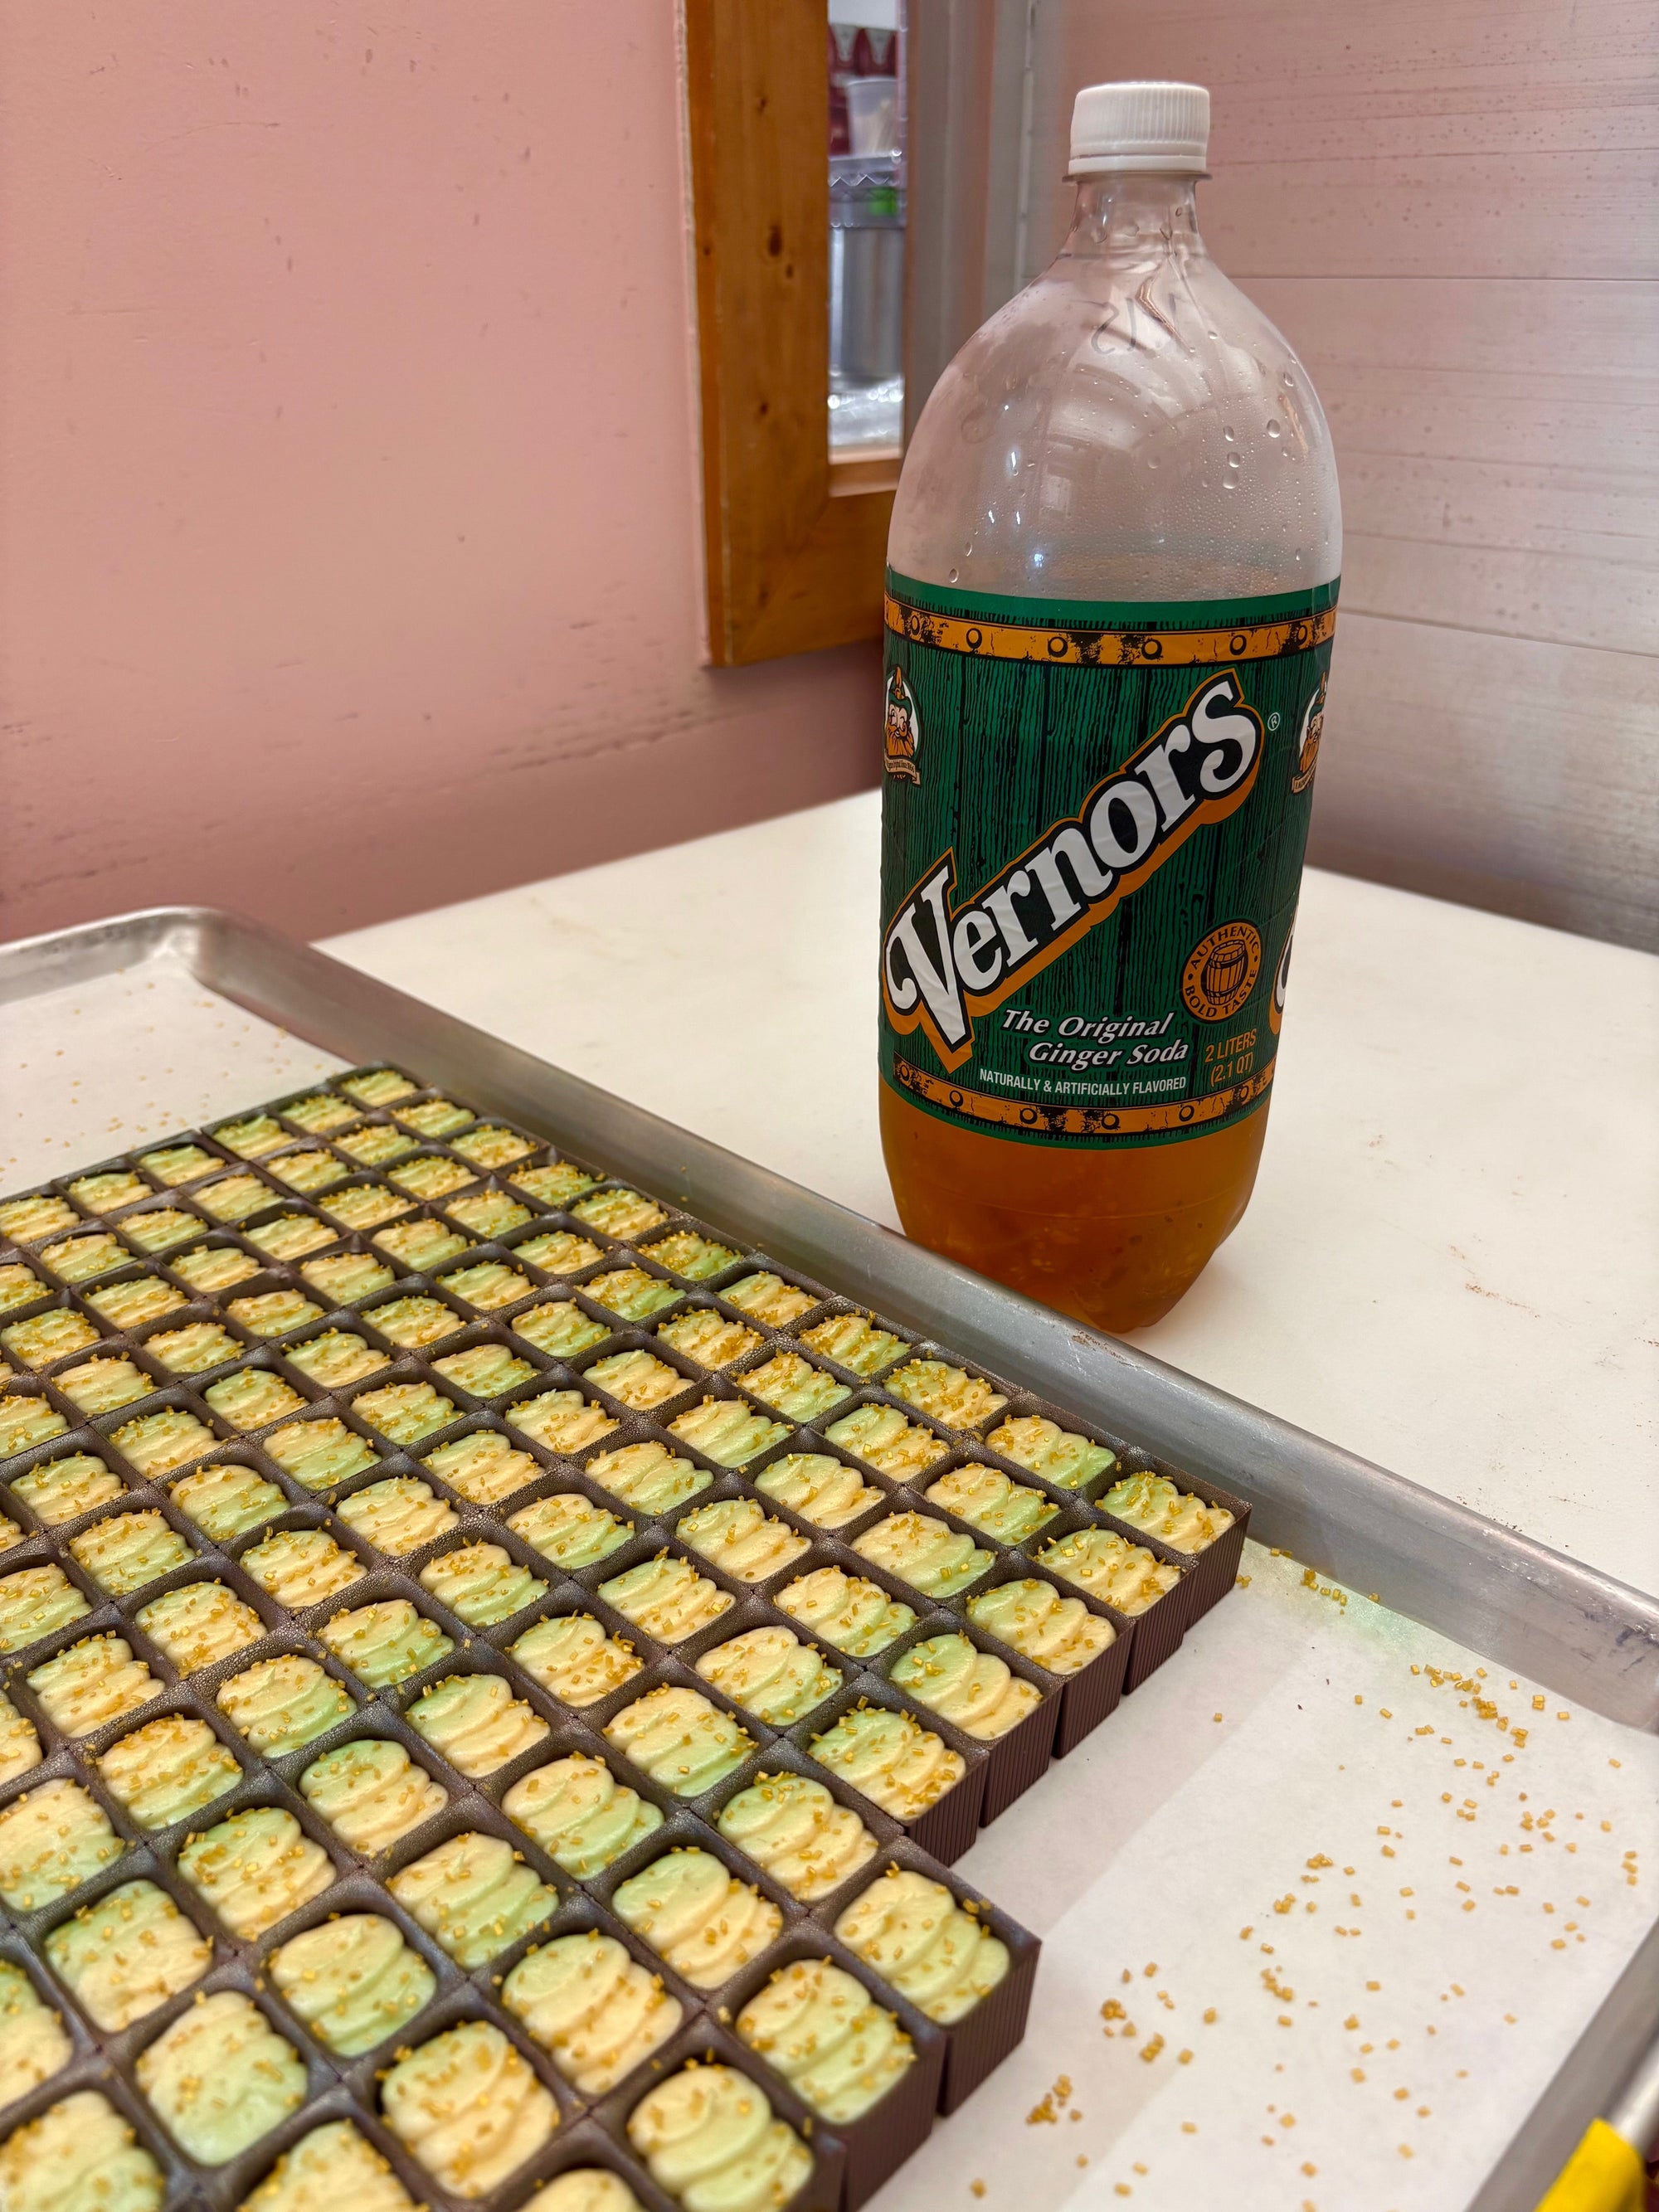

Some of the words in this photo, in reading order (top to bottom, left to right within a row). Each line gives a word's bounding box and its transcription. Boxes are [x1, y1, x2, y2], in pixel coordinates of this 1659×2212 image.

[886, 680, 1256, 1044] Vernors
[1190, 926, 1259, 970] AUTHENTIC
[1185, 985, 1218, 1018] BOLD
[1222, 969, 1258, 1014] TASTE
[1003, 1009, 1050, 1033] The
[1058, 1013, 1174, 1044] Original
[1029, 1043, 1121, 1071] Ginger
[1126, 1039, 1189, 1065] Soda
[1204, 1045, 1214, 1062] 2
[1217, 1028, 1257, 1059] LITERS
[980, 1068, 1041, 1091] NATURALLY
[1043, 1080, 1052, 1092] &
[1055, 1081, 1130, 1096] ARTIFICIALLY
[1132, 1077, 1186, 1094] FLAVORED
[1211, 1061, 1233, 1087] (2.1
[1236, 1052, 1253, 1074] QT)
